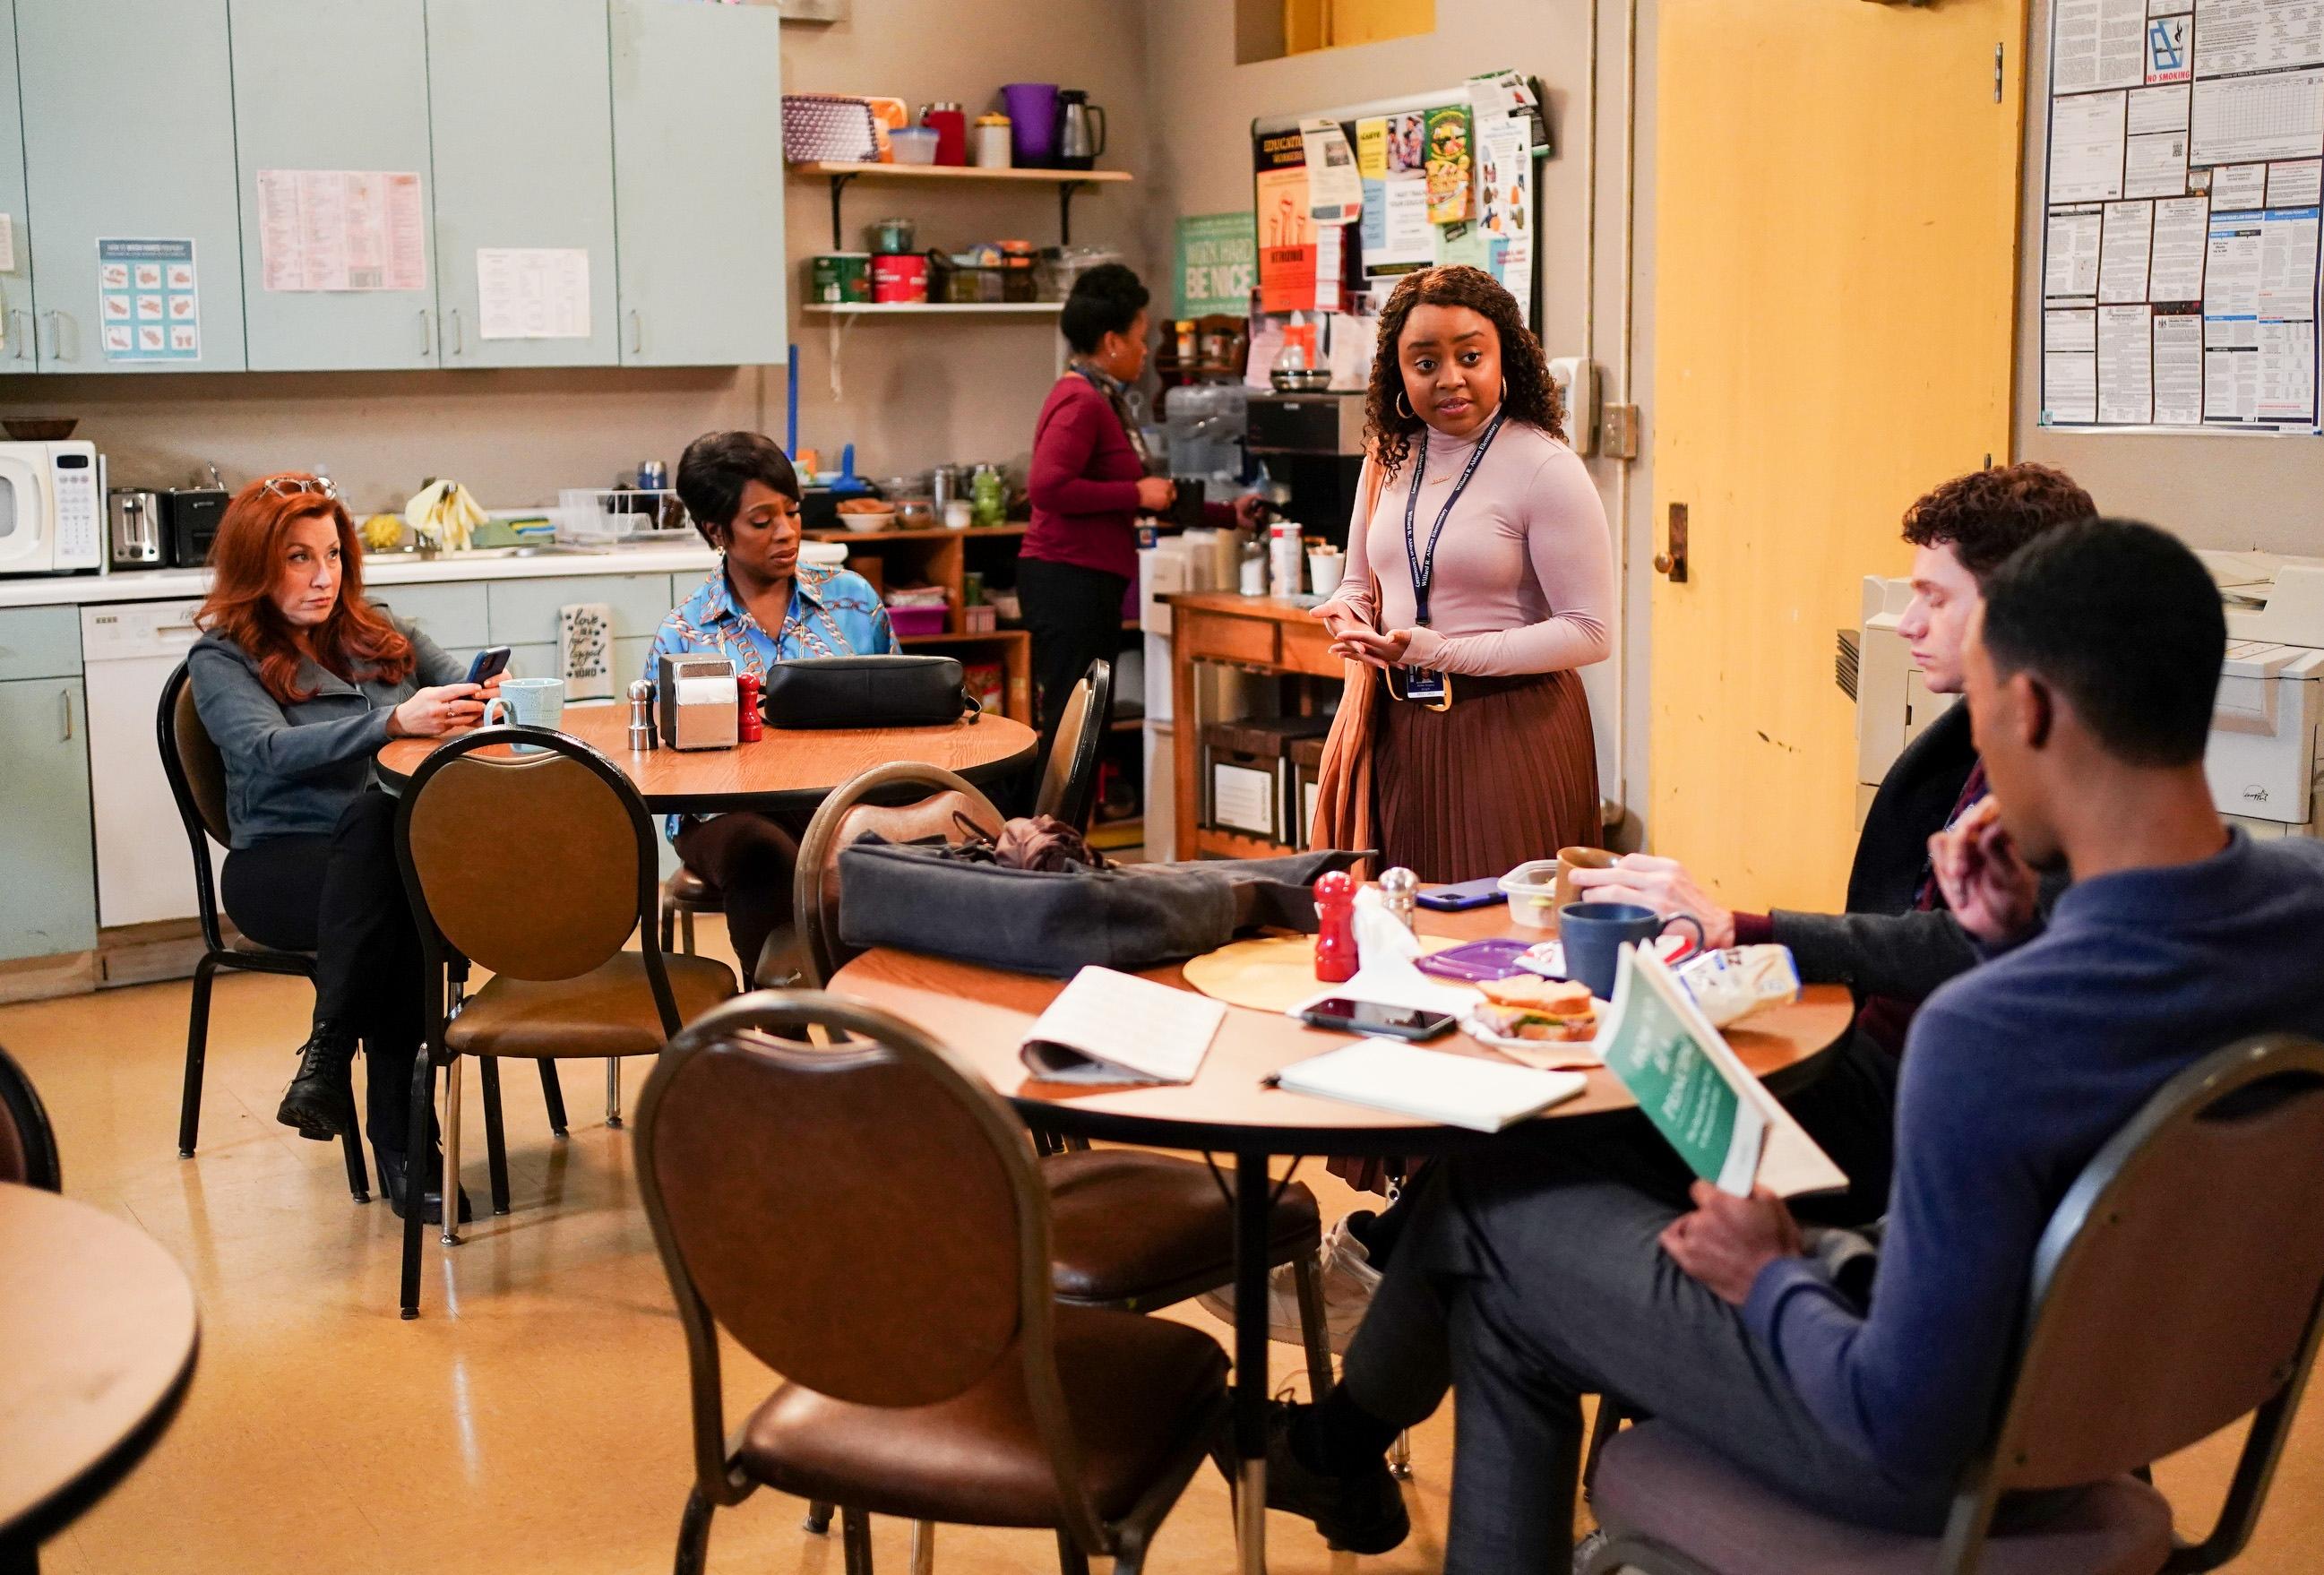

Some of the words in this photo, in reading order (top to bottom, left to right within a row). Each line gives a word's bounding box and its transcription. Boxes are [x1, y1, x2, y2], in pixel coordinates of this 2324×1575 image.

[2147, 74, 2156, 82] NO
[2159, 71, 2191, 82] SMOKING
[1186, 267, 1209, 298] BE
[1210, 263, 1253, 297] NICE
[1455, 473, 1469, 492] Willard
[1469, 450, 1483, 467] Abbott
[1478, 423, 1499, 450] Elementary
[1421, 565, 1430, 587] Willard
[1426, 538, 1434, 557] Abbott
[1432, 508, 1449, 538] Elementary
[1411, 556, 1421, 588] Elementary
[574, 608, 598, 625] love
